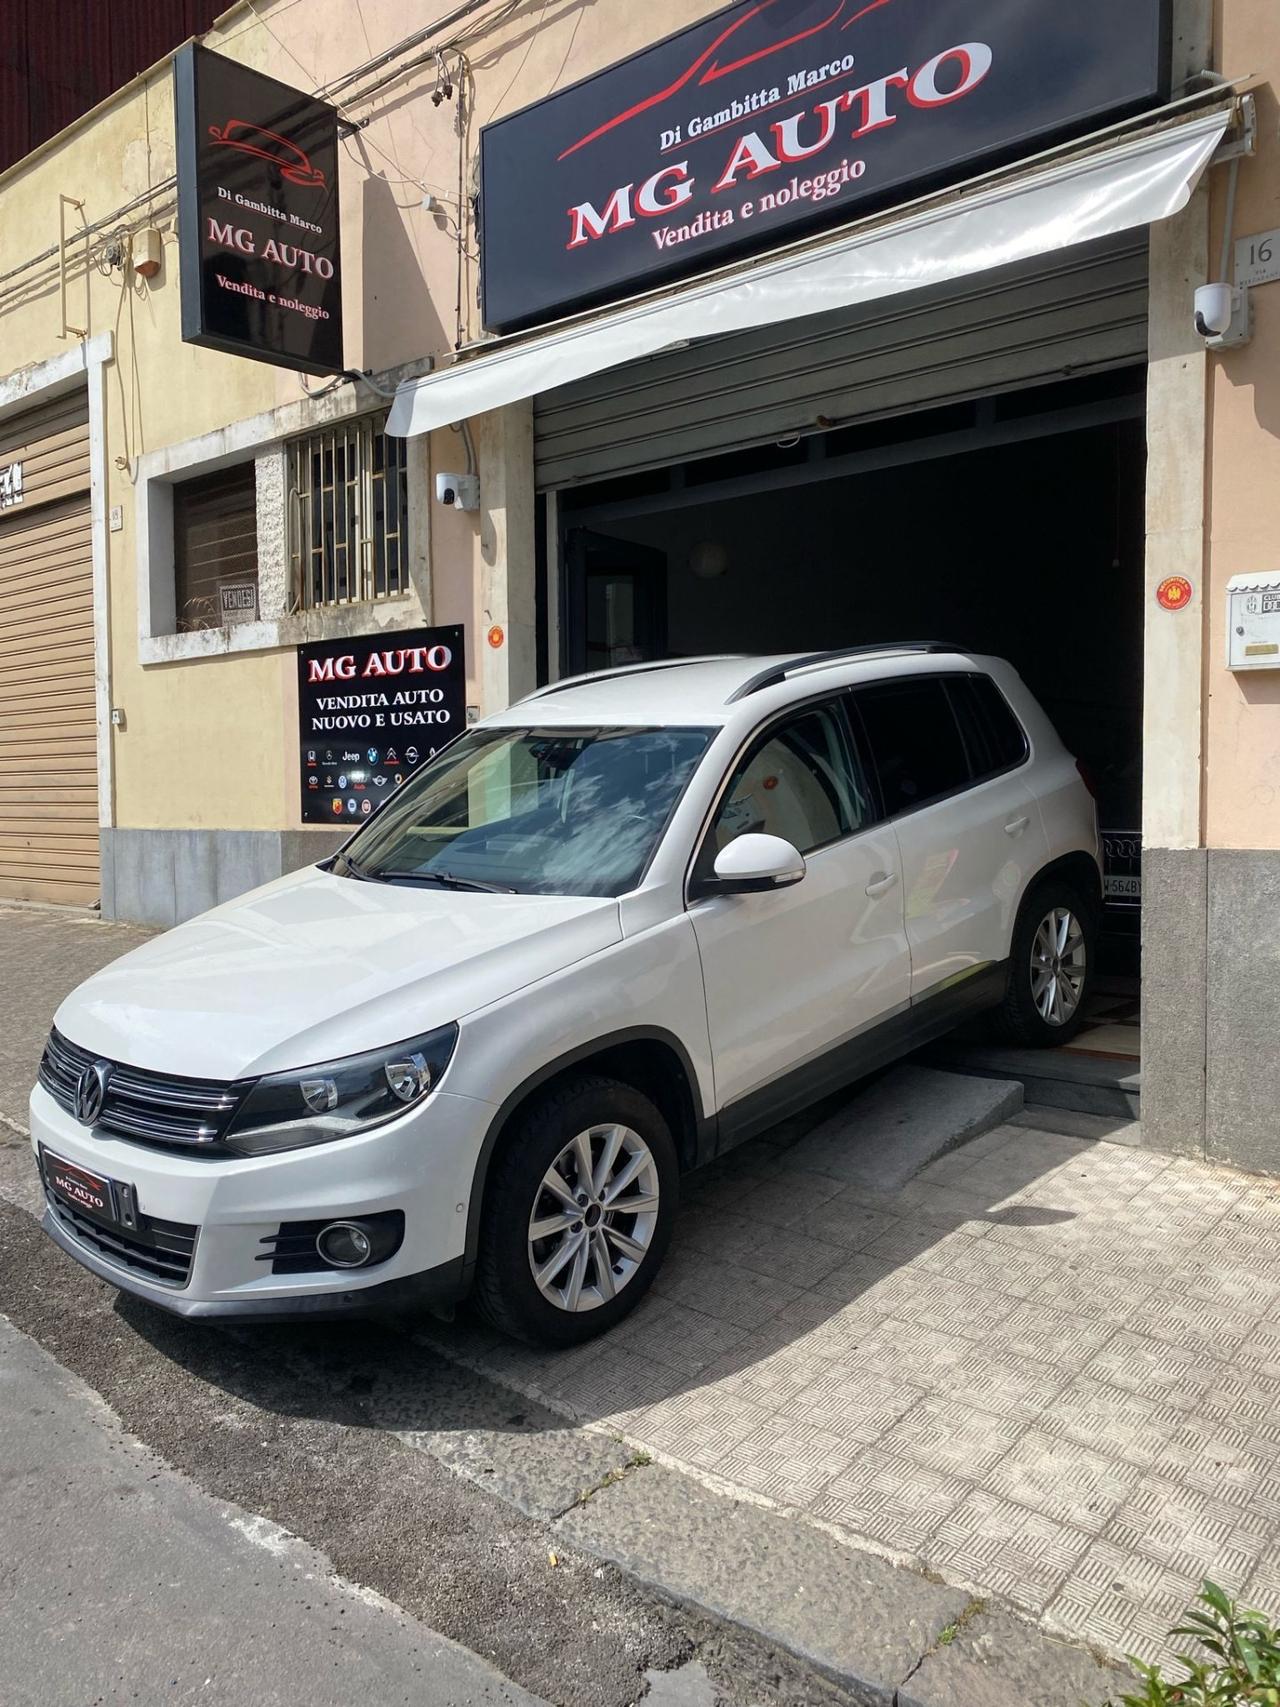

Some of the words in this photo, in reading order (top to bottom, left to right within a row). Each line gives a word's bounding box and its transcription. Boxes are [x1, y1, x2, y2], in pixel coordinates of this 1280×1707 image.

[659, 125, 682, 151] Di
[687, 86, 780, 138] Gambitta
[787, 54, 855, 96] Marco
[566, 160, 696, 249] MG
[710, 42, 993, 194] AUTO
[217, 186, 232, 200] Di
[235, 193, 288, 221] Gambitta
[290, 213, 323, 234] Marco
[652, 208, 734, 250] Vendita
[740, 202, 755, 219] e
[759, 158, 867, 211] noleggio
[207, 217, 256, 254] MG
[261, 238, 335, 280] AUTO
[1250, 238, 1273, 265] 16
[215, 273, 266, 300] Vendita
[268, 293, 277, 304] e
[279, 297, 331, 320] noleggio
[222, 589, 254, 609] VENDESI
[307, 655, 357, 683] MG
[361, 645, 453, 678] AUTO
[316, 692, 390, 711] VENDITA
[392, 688, 445, 705] AUTO
[312, 713, 371, 731] NUOVO
[375, 713, 386, 727] E
[390, 709, 450, 726] USATO
[342, 751, 360, 763] Jeep
[55, 1176, 72, 1192] MG
[74, 1187, 104, 1208] AUTO
